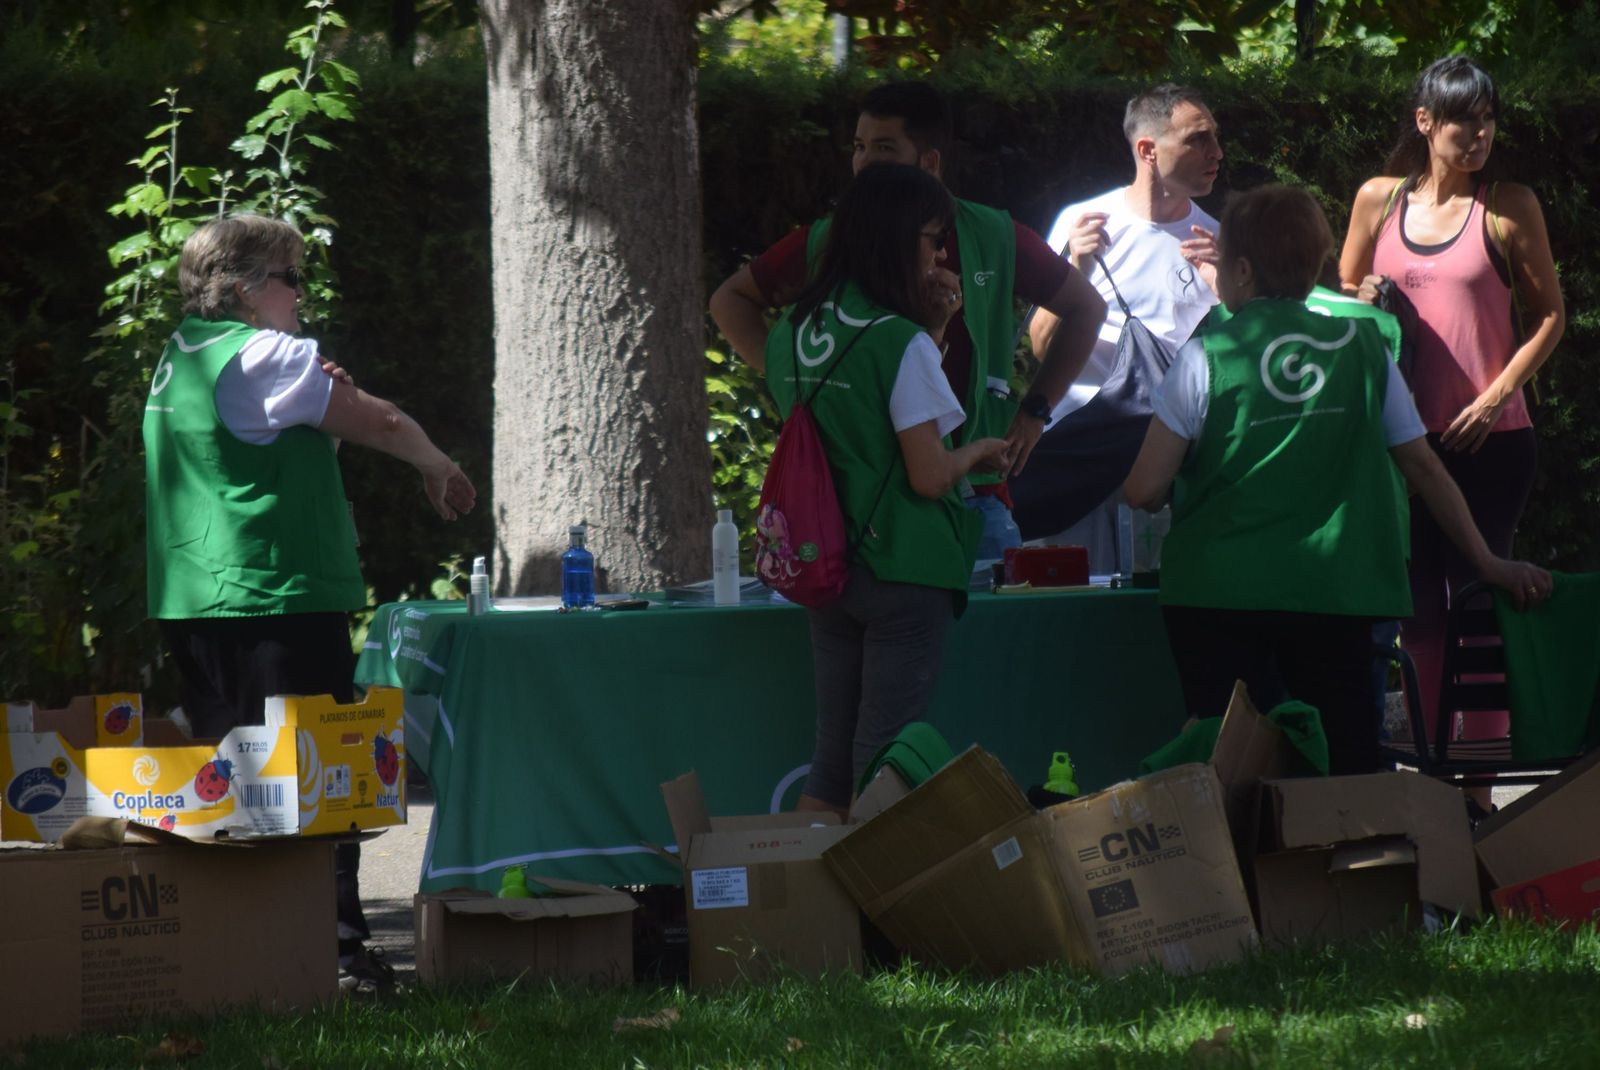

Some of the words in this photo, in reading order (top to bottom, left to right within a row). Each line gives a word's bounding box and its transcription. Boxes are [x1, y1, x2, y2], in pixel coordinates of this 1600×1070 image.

[358, 709, 385, 721] CANARIAS
[238, 742, 251, 753] 17
[113, 790, 185, 814] Coplaca
[376, 793, 399, 807] Natur
[1100, 823, 1162, 862] CN
[1085, 865, 1121, 881] CLUB
[1126, 848, 1186, 870] NAUTICO
[101, 873, 159, 920] CN
[81, 928, 118, 941] CLUB
[122, 922, 181, 937] NAUTICO
[1100, 930, 1152, 950] ARTICULO
[1103, 945, 1139, 960] COLOR
